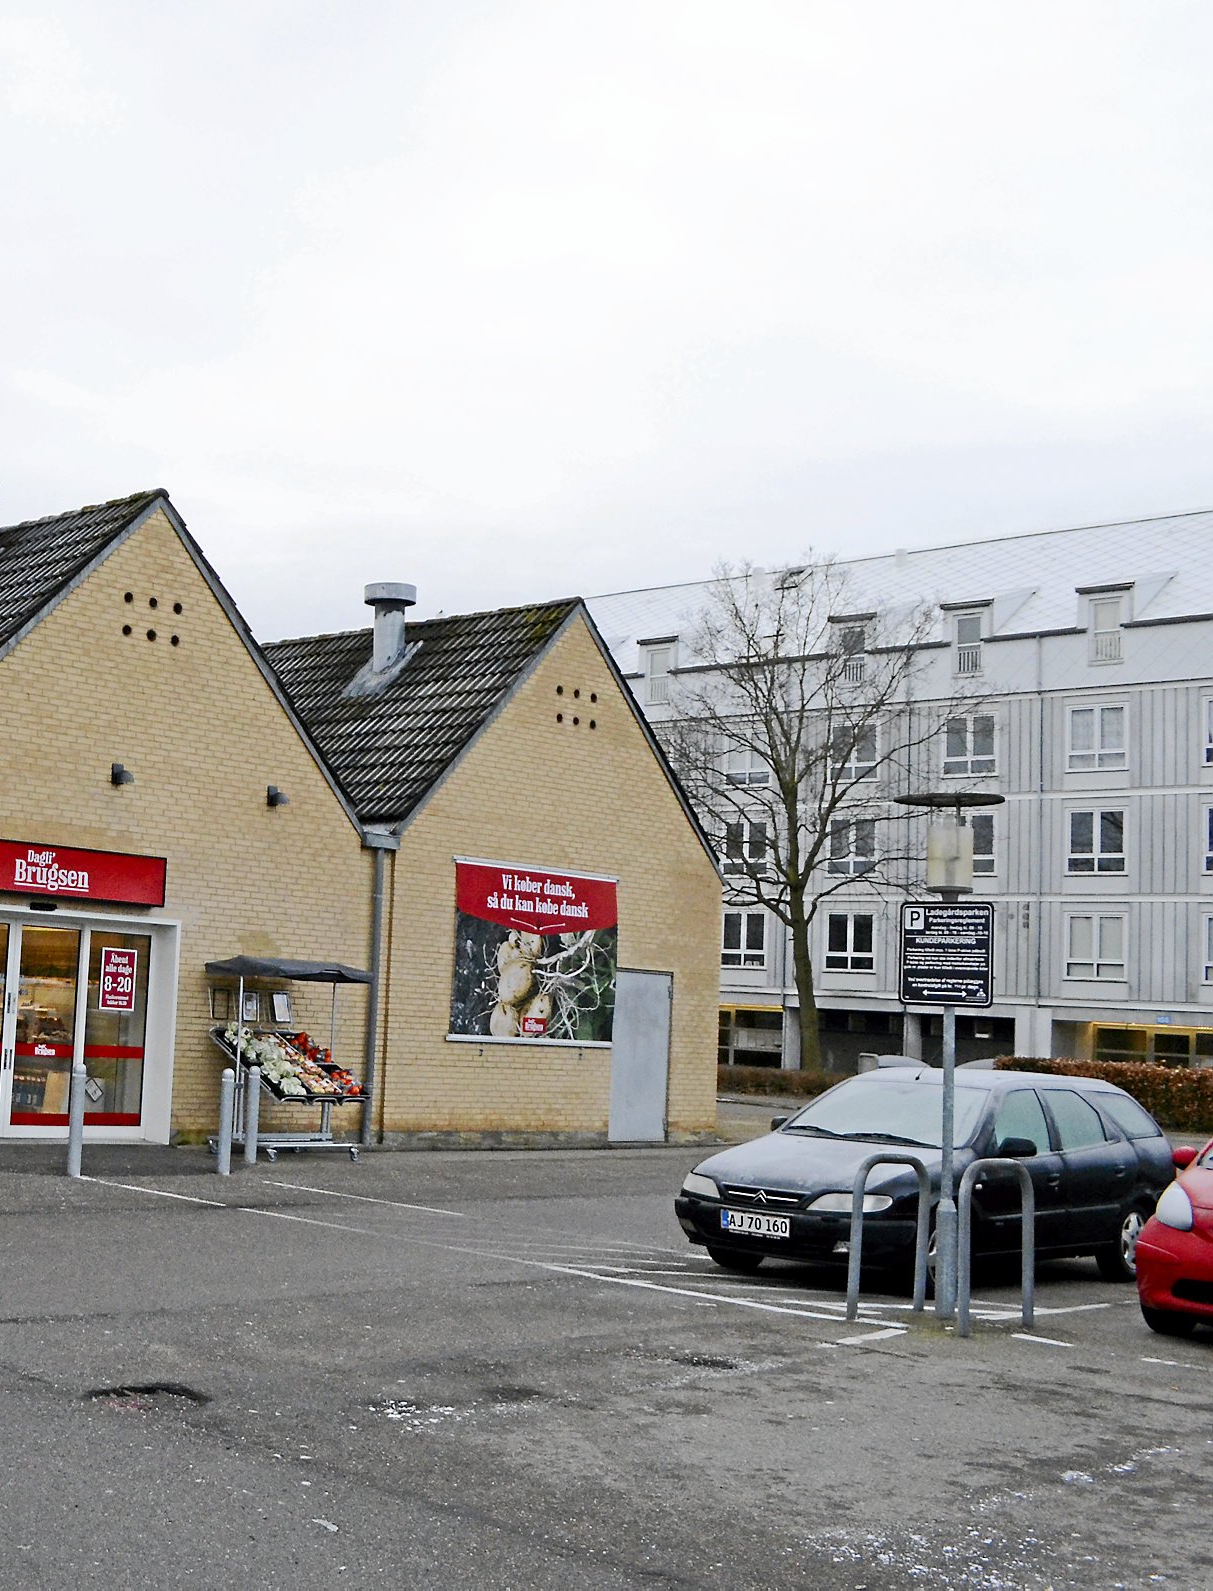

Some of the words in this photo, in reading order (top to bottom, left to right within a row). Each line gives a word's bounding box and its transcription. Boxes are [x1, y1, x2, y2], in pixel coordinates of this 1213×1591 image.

[14, 858, 89, 891] Brugsen
[502, 874, 513, 890] Vi
[544, 879, 576, 900] dansk,
[487, 891, 499, 909] så
[500, 893, 513, 910] du
[515, 895, 534, 912] kan
[560, 900, 589, 918] dansk
[910, 910, 921, 927] P
[104, 975, 132, 992] 8-20
[729, 1214, 744, 1228] AJ
[748, 1216, 762, 1230] 70
[765, 1219, 788, 1234] 160
